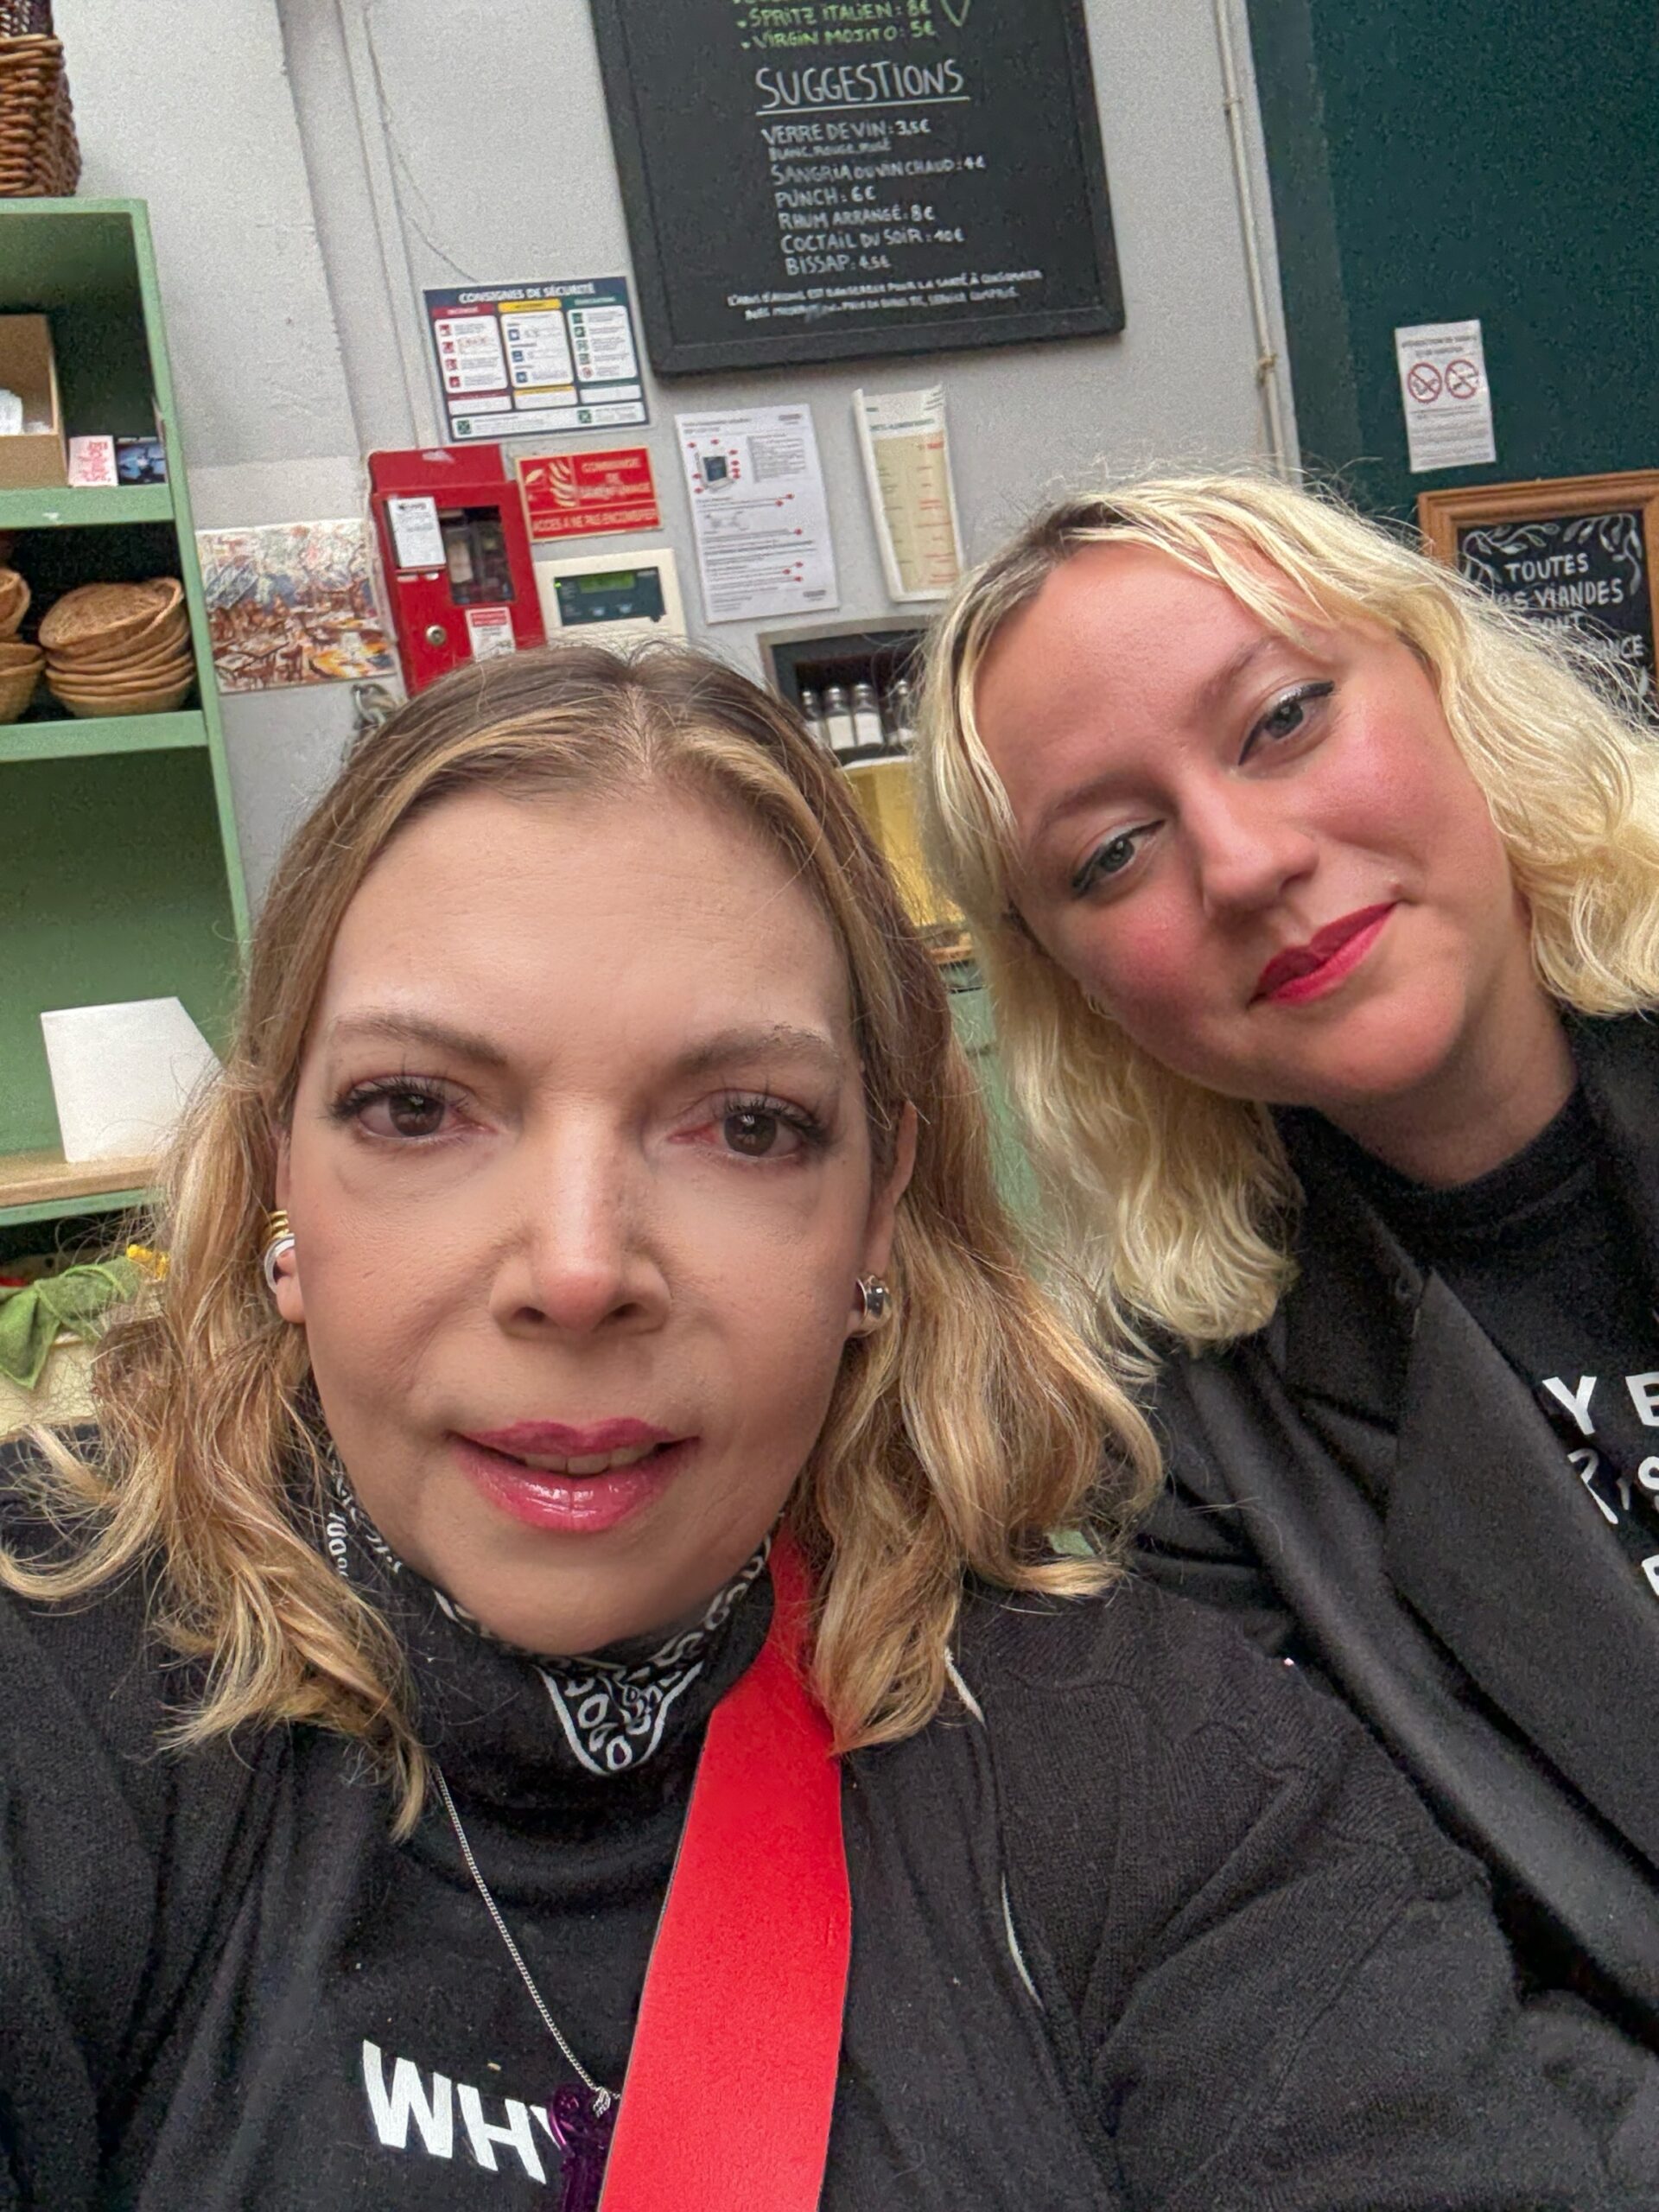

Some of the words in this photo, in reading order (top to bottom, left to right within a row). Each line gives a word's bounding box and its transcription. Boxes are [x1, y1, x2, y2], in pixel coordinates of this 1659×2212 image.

[748, 7, 817, 27] SPRITZ
[752, 30, 819, 49] VIRGIN
[755, 59, 964, 109] SUGGESTIONS
[761, 124, 824, 145] VERRE
[827, 122, 850, 140] DE
[771, 163, 854, 186] SANGRIA
[778, 212, 830, 230] RHUM
[780, 231, 857, 253] COCTAIL
[1504, 552, 1590, 582] TOUTES
[1535, 578, 1625, 609] VIANDES
